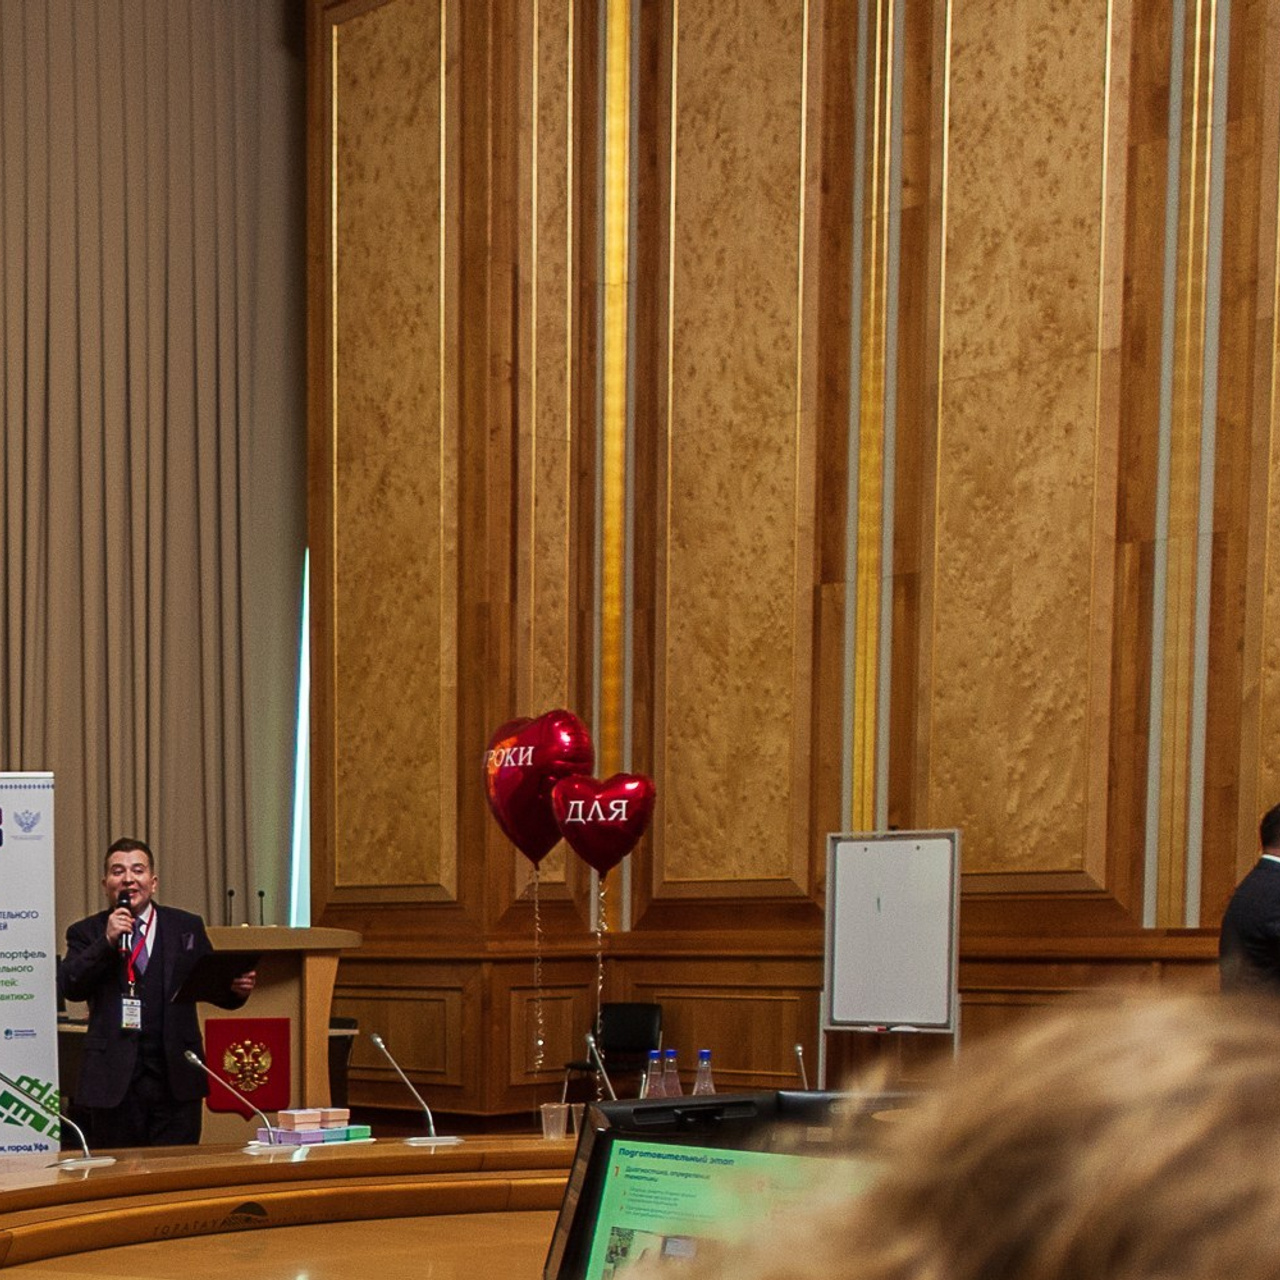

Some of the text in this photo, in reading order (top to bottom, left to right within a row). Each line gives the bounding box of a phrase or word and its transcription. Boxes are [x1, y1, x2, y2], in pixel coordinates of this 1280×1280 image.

[565, 800, 629, 824] ДЛЯ
[0, 950, 46, 961] портфель
[8, 1144, 33, 1153] город
[34, 1143, 49, 1152] Уфа
